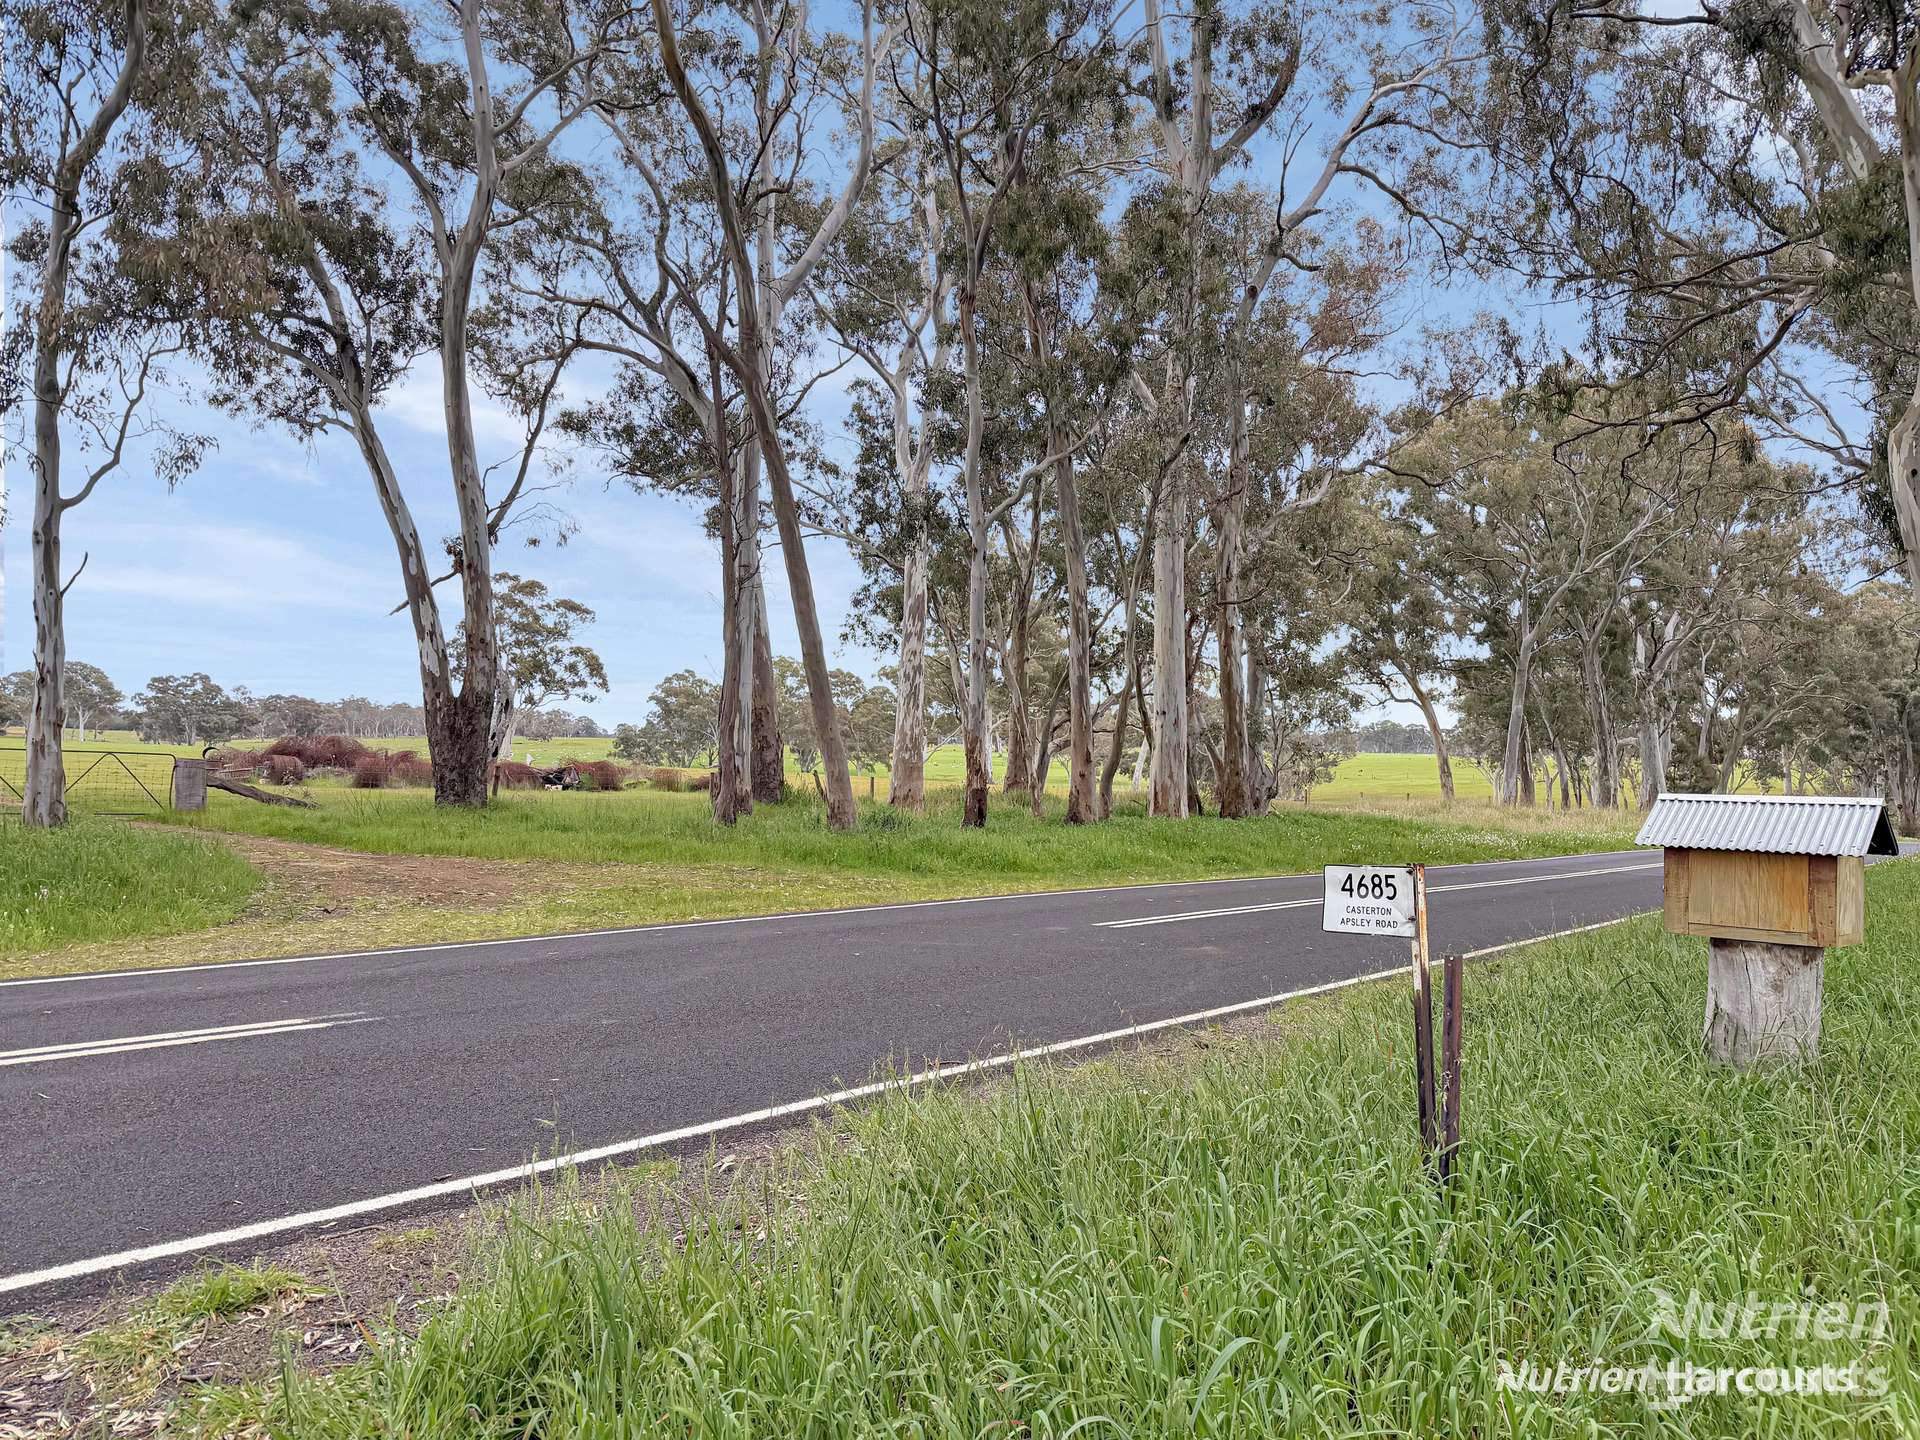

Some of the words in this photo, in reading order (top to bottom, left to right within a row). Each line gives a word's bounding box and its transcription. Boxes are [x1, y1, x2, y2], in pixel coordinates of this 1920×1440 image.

[1341, 873, 1397, 900] 4685
[1346, 905, 1392, 916] CASTERTON
[1340, 917, 1371, 928] APSLEY
[1375, 919, 1398, 929] ROAD
